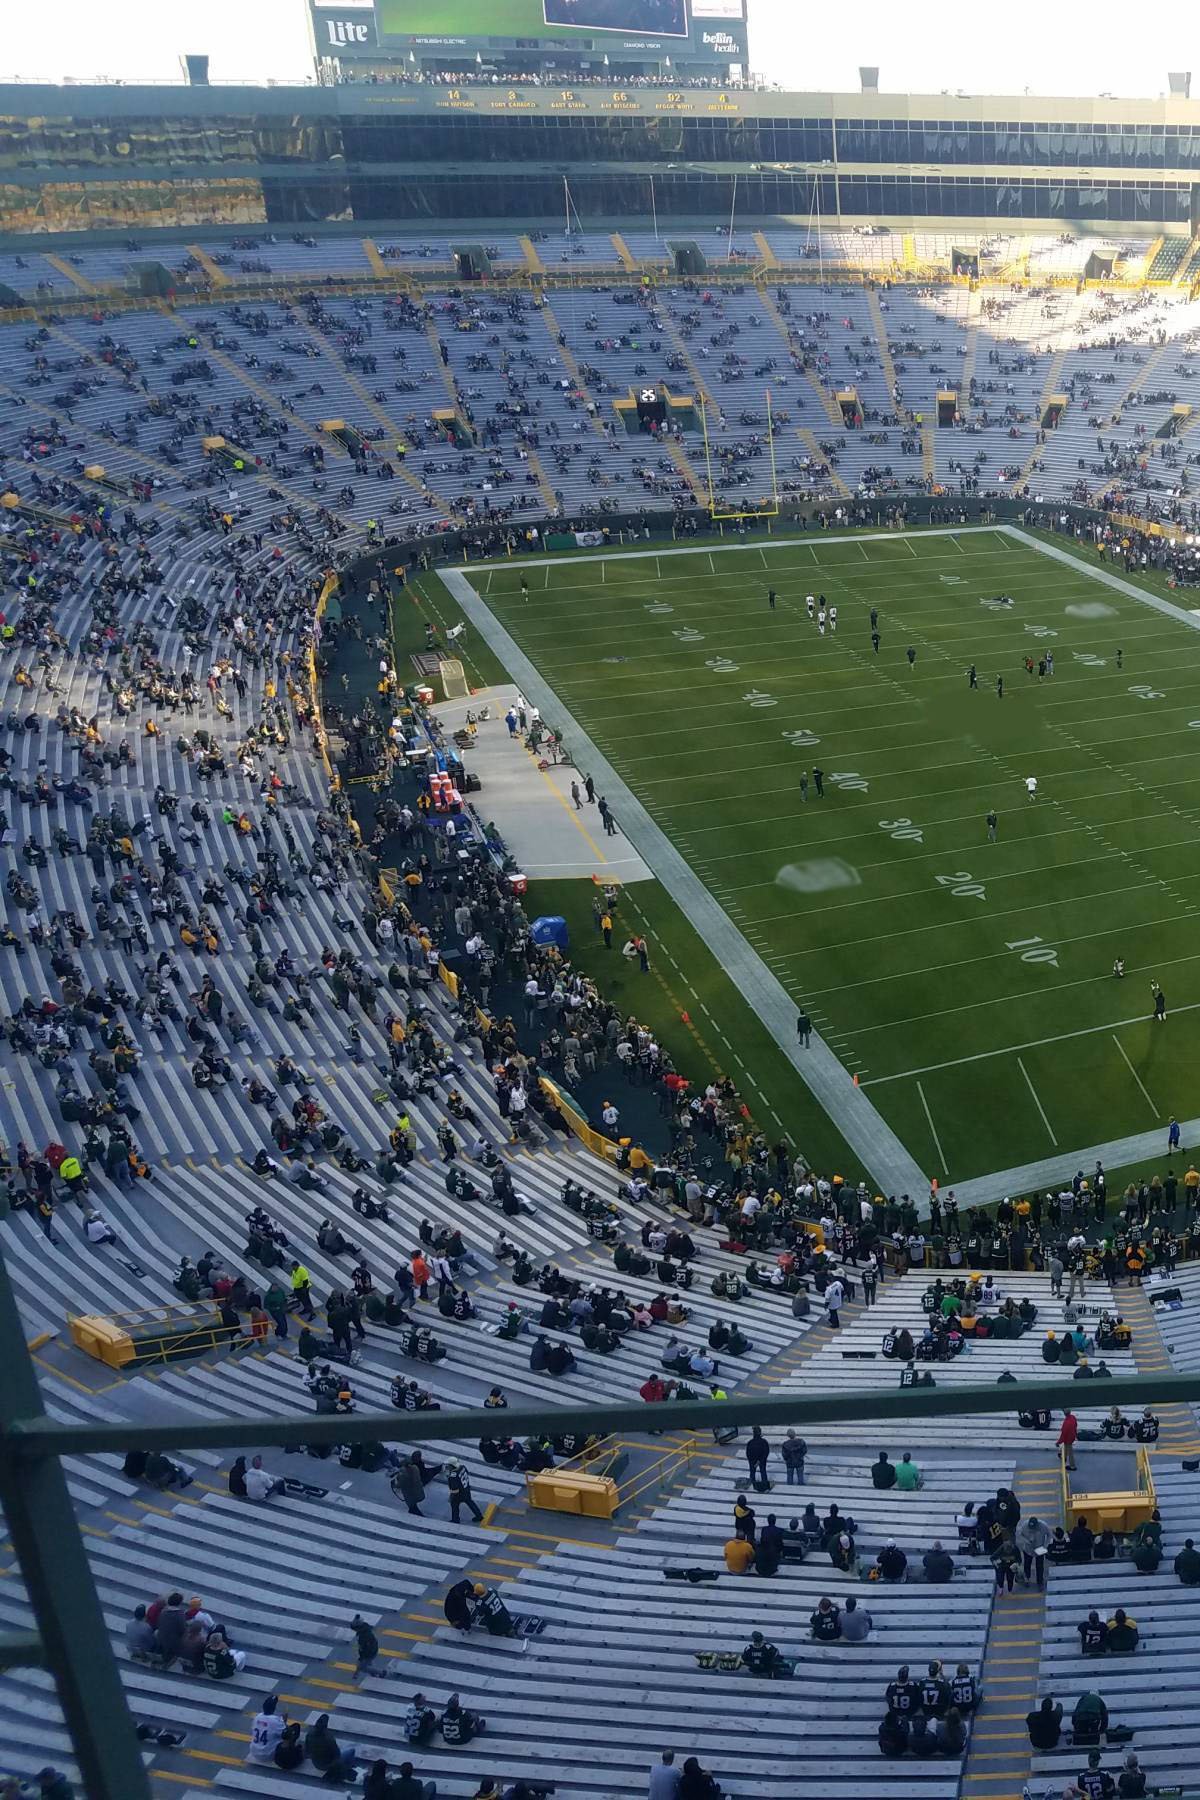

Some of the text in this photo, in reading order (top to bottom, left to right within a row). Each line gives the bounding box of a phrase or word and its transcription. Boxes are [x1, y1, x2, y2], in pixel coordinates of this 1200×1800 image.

[326, 21, 368, 47] Lite
[702, 32, 733, 44] bellin
[714, 43, 739, 53] health
[448, 90, 460, 99] 14
[560, 91, 573, 101] 15
[613, 93, 627, 101] 66
[641, 389, 656, 401] 25
[939, 574, 968, 585] 10
[644, 601, 674, 614] 10
[672, 627, 705, 642] 20
[1024, 624, 1059, 637] 30
[705, 657, 740, 673] 30
[1072, 652, 1106, 666] 40
[742, 690, 778, 708] 40
[1127, 685, 1166, 699] 50
[781, 729, 821, 746] 50
[829, 771, 867, 790] 40
[878, 818, 918, 840] 30
[935, 872, 978, 898] 20
[1005, 936, 1054, 964] 10
[924, 1298, 935, 1308] 12
[883, 1340, 894, 1352] 12
[903, 1374, 913, 1385] 12
[922, 1690, 940, 1705] 17
[953, 1686, 972, 1703] 38
[253, 1729, 268, 1745] 34
[1085, 1783, 1102, 1800] 12
